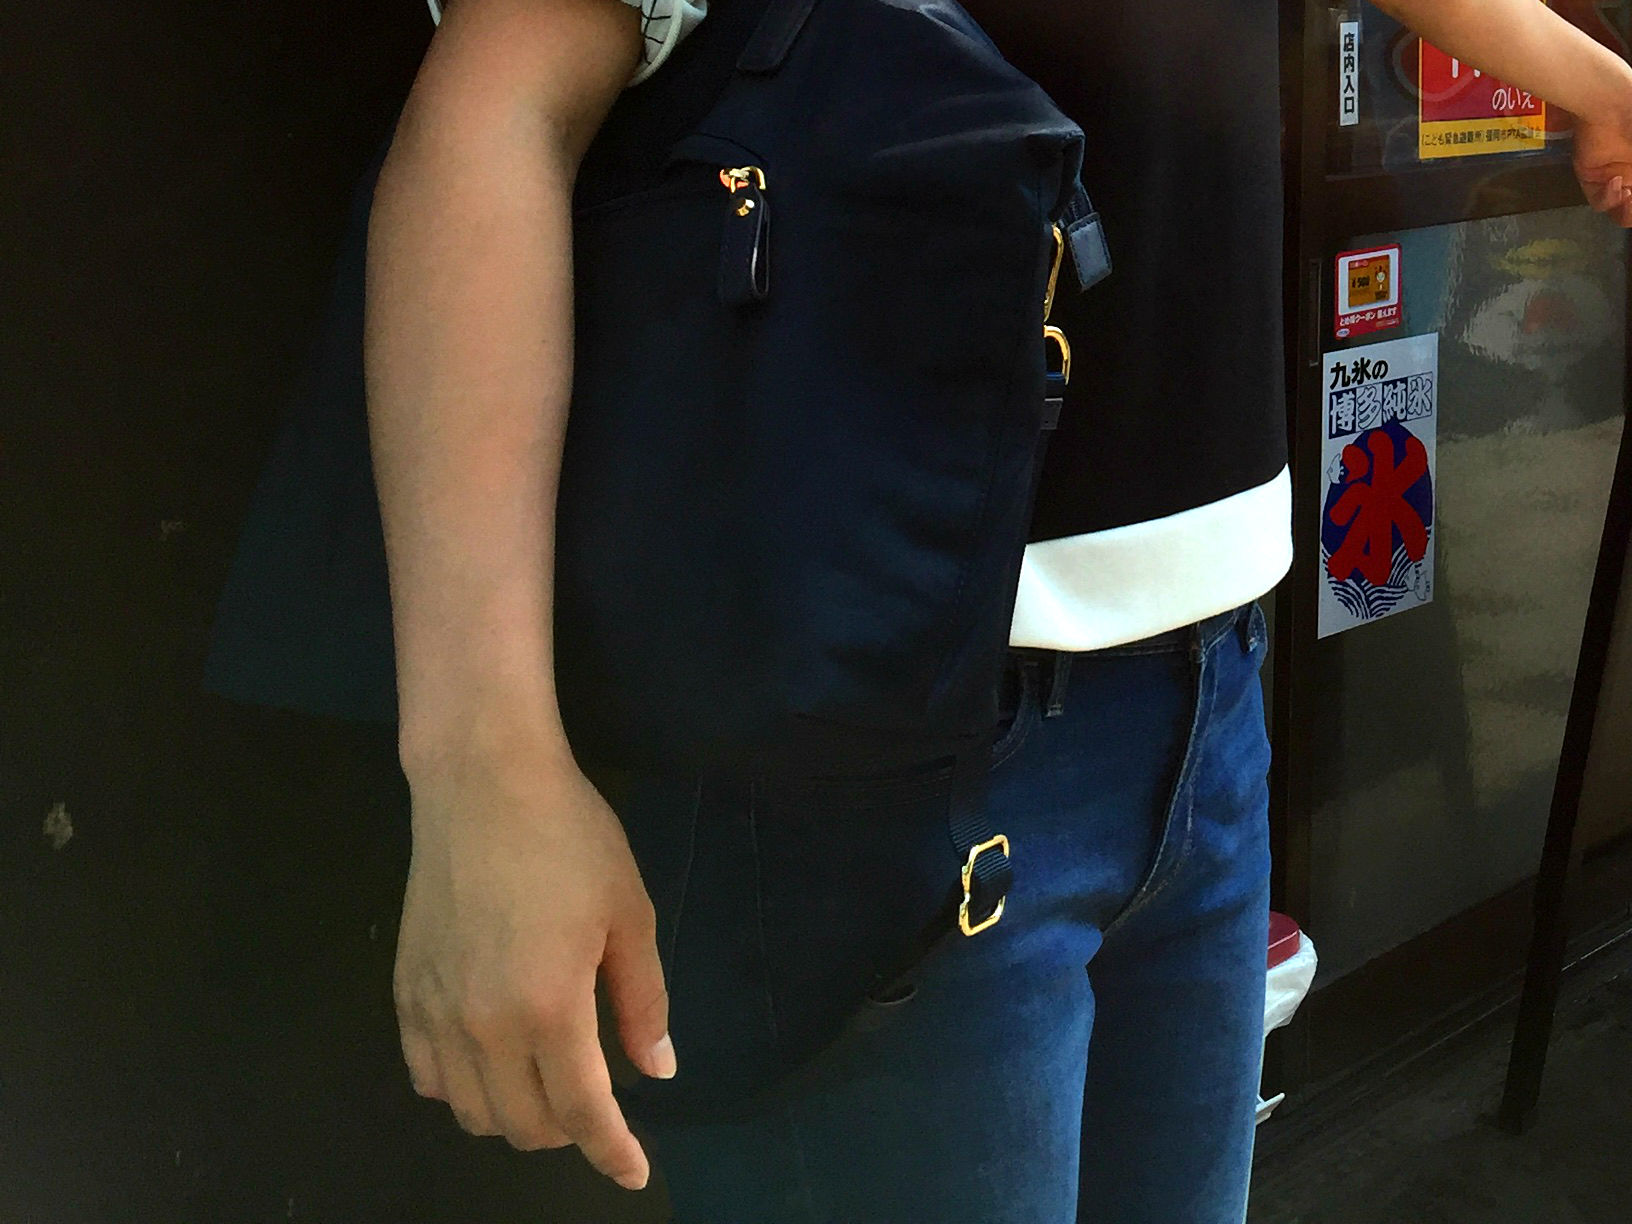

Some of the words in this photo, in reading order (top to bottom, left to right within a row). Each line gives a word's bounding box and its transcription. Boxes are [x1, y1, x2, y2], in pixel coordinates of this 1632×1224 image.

[1342, 32, 1356, 114] 店内入口
[1491, 87, 1535, 111] のいえ
[1329, 356, 1389, 390] 九氷の
[1329, 375, 1433, 435] 博多純氷
[1327, 430, 1429, 587] 氷
